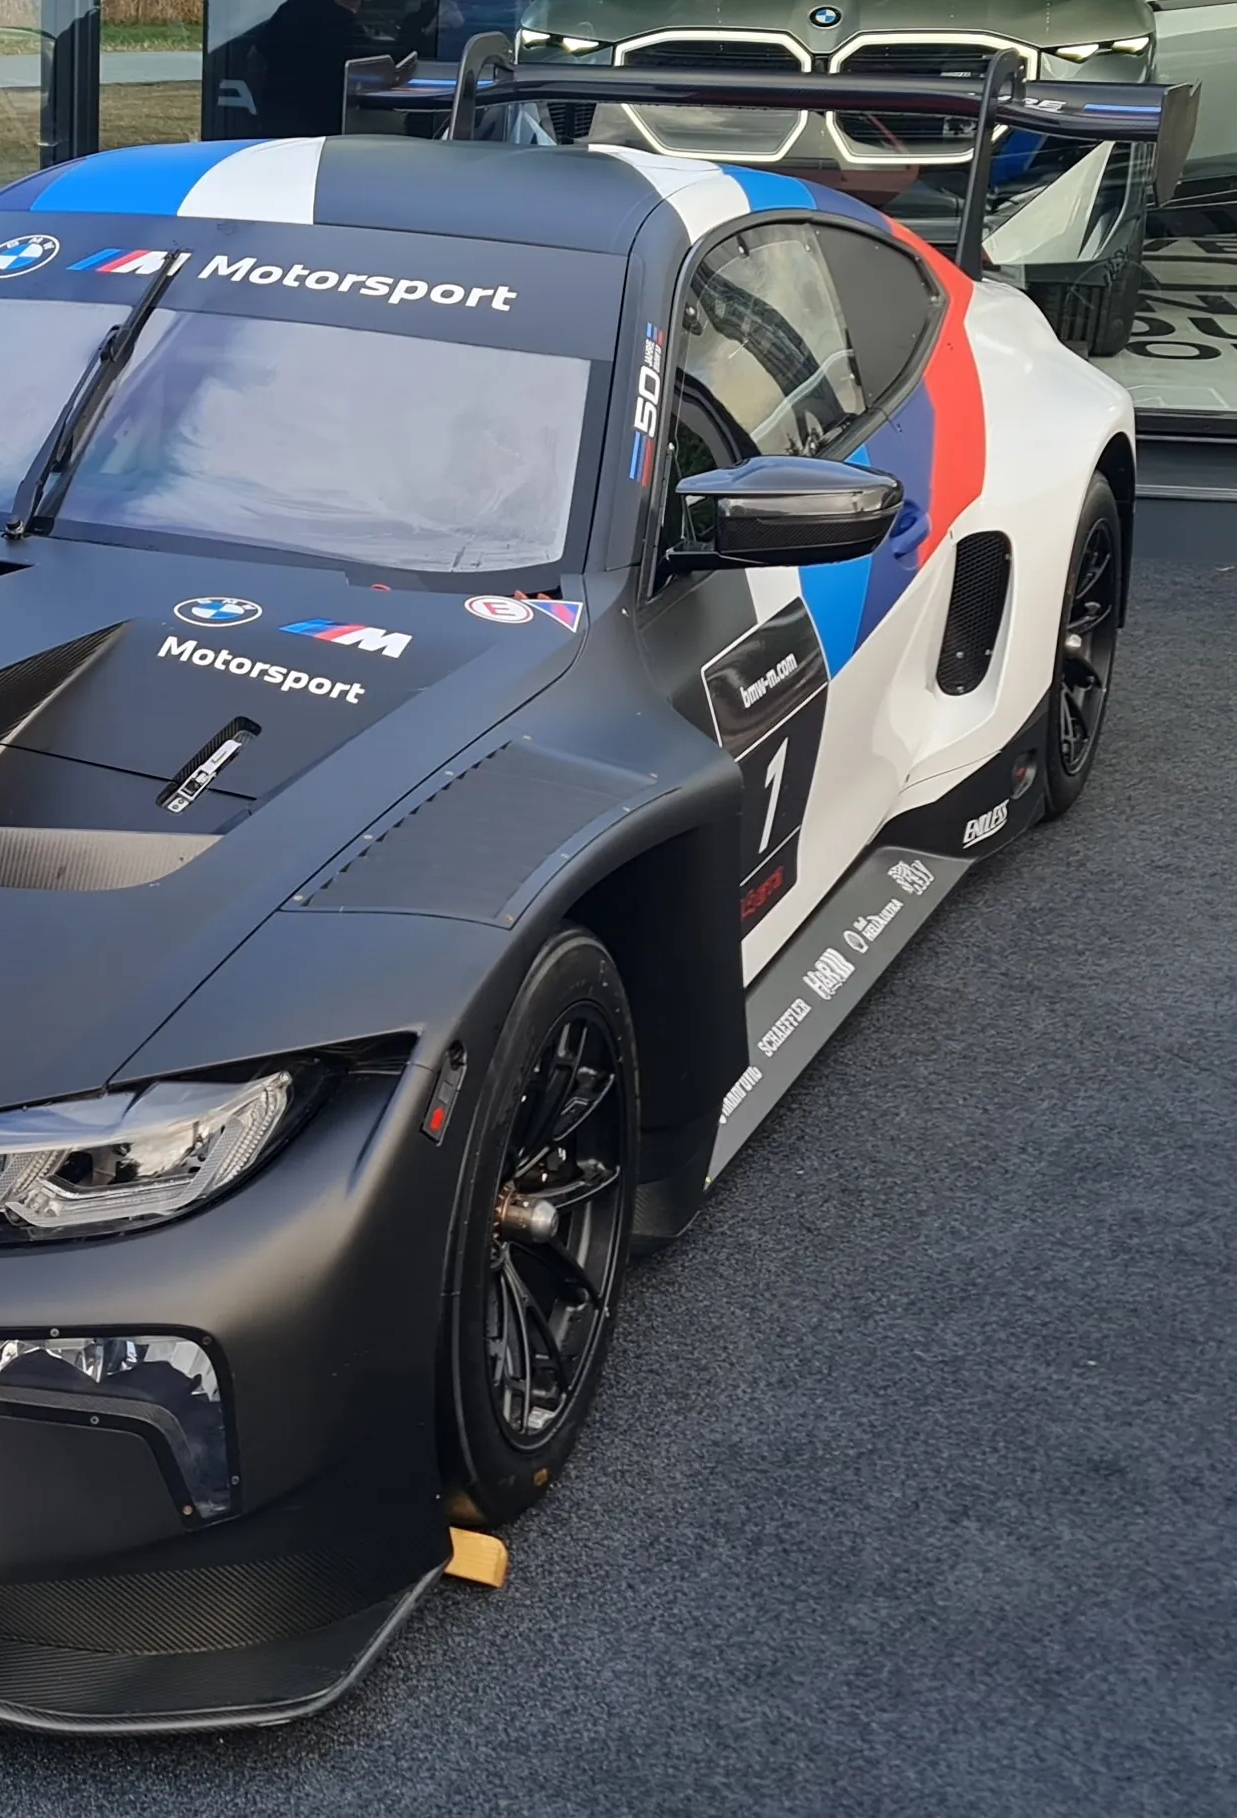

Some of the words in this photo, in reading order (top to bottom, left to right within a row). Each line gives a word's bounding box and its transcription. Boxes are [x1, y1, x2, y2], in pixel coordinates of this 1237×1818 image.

[198, 254, 518, 312] Motorsport
[634, 365, 661, 438] 50
[157, 635, 366, 705] Motorsport
[739, 652, 798, 709] bmw-m.com
[758, 736, 789, 854] 1
[757, 998, 812, 1058] SCHAEFFLER
